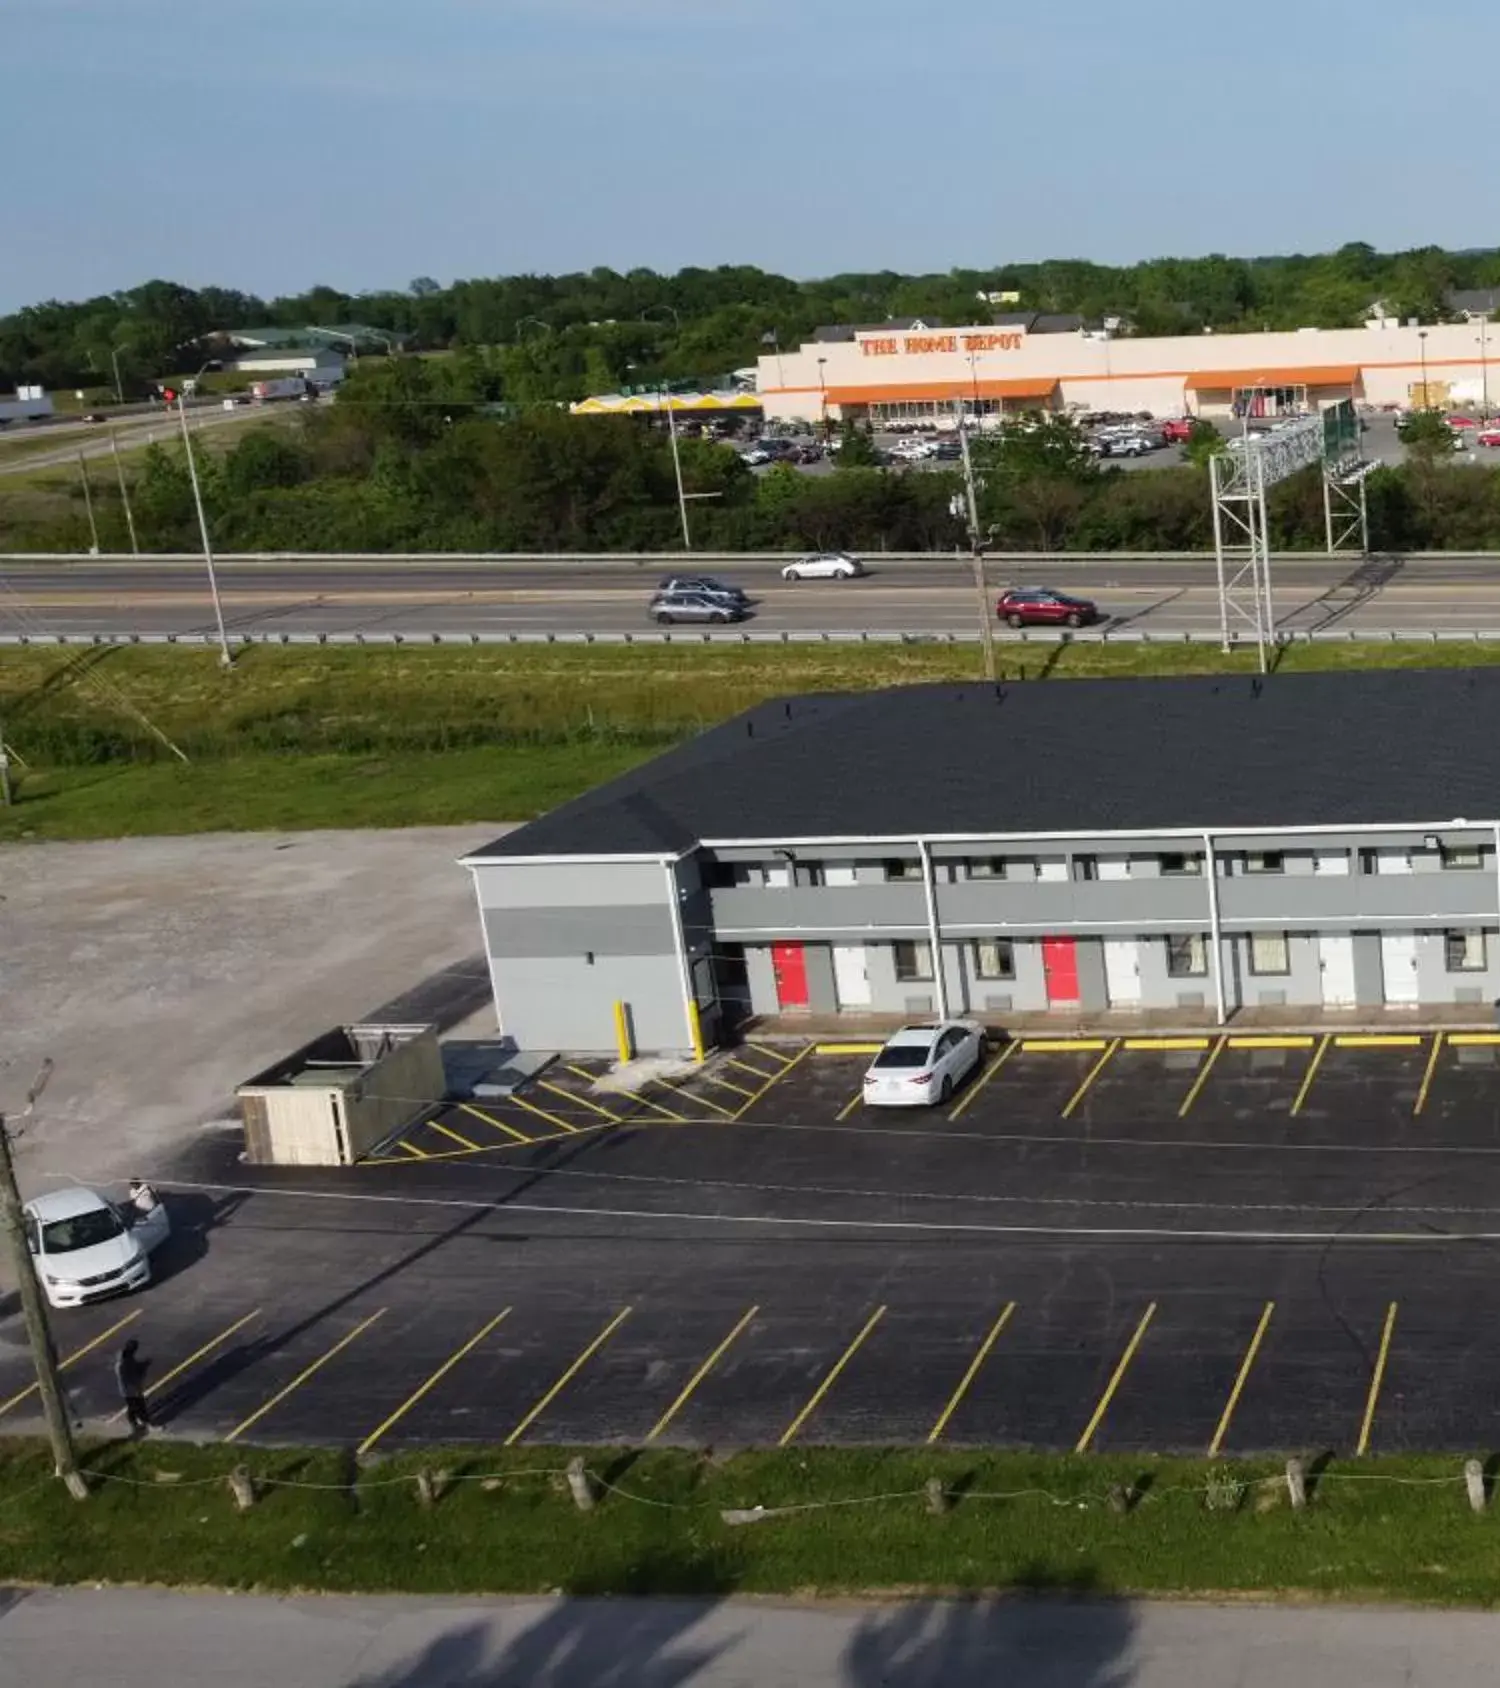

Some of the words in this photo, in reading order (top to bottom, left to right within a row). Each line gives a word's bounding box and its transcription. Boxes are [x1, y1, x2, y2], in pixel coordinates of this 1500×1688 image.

[861, 339, 897, 356] THE
[904, 335, 956, 353] HOME
[963, 332, 1022, 351] DEPOT
